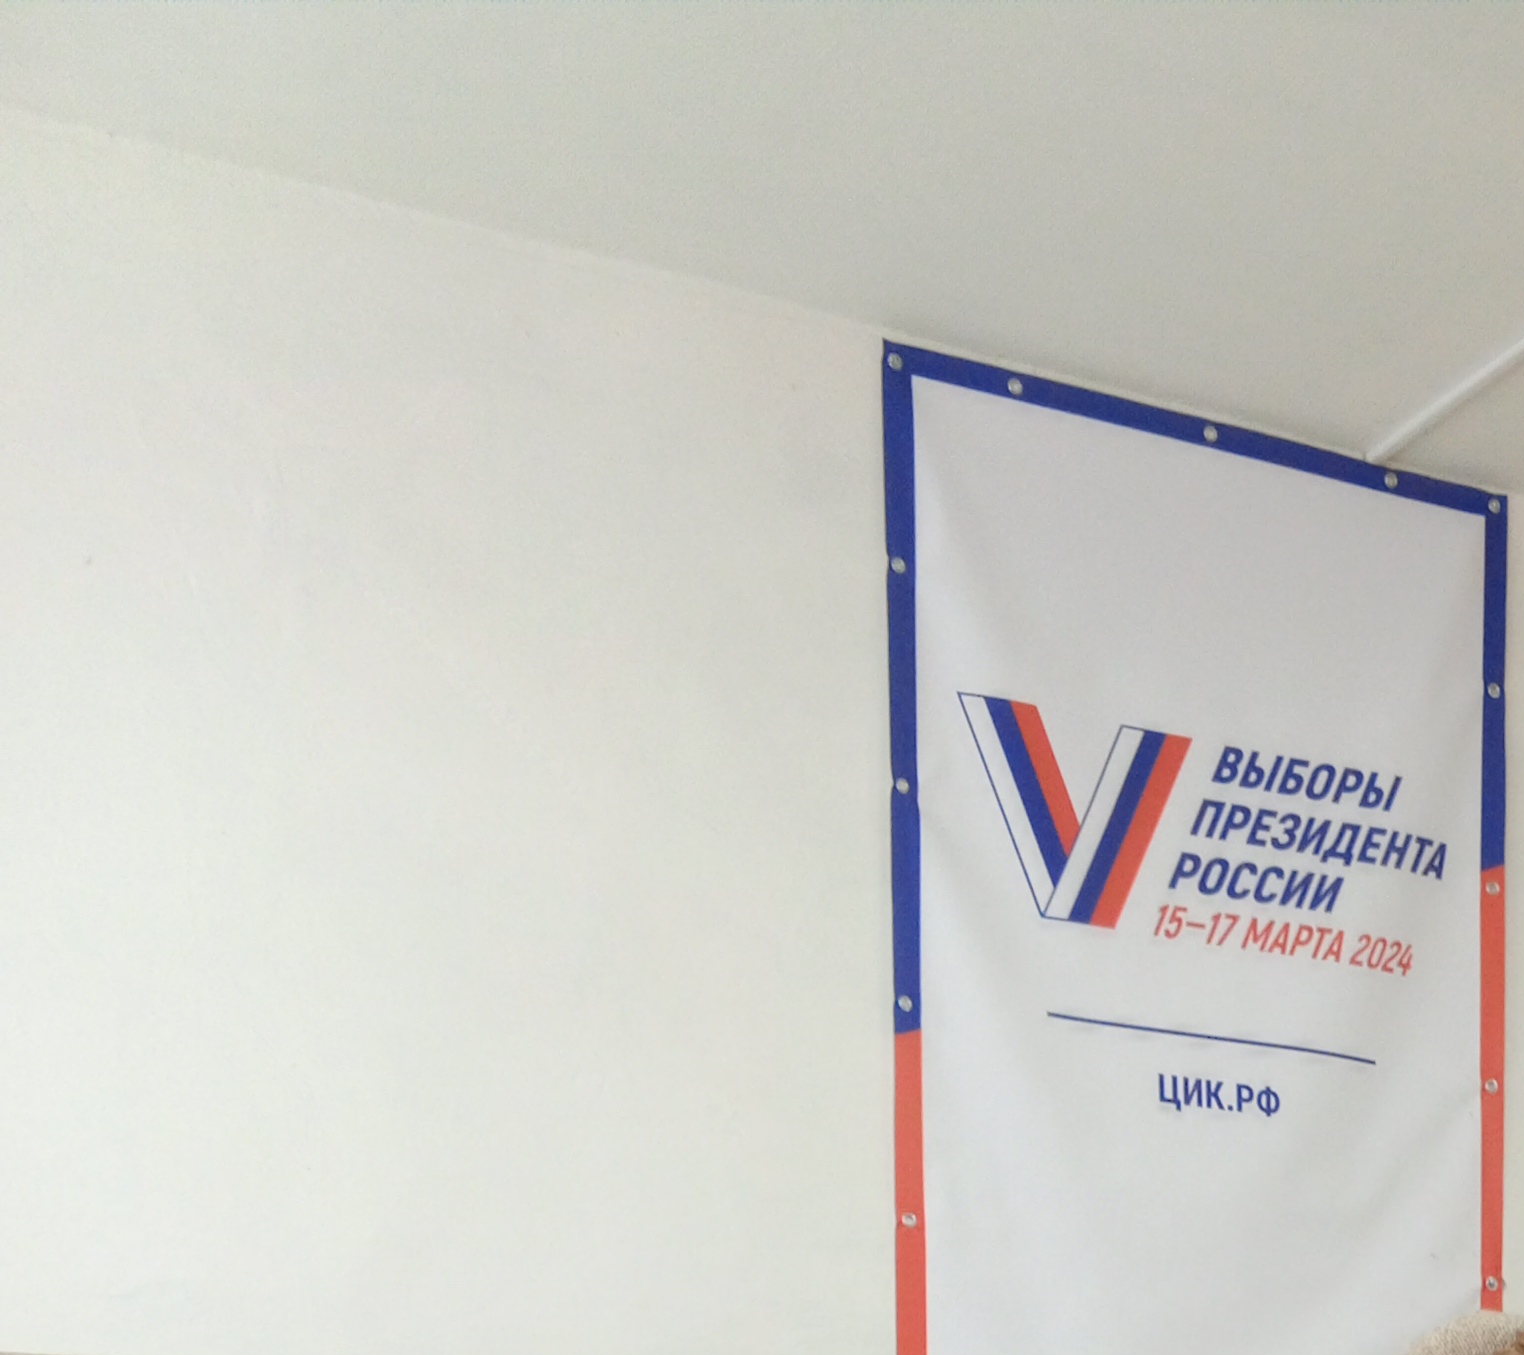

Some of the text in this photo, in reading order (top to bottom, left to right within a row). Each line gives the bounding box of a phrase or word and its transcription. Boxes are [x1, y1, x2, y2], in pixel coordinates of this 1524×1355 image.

[1211, 745, 1403, 812] ВЫБОРЫ
[1190, 798, 1448, 880] ПРЕЗИДЕНТА
[1168, 852, 1344, 914] РОССИИ
[1241, 920, 1345, 964] МАРТА
[1349, 933, 1414, 977] 2024
[1158, 1073, 1281, 1118] ЦИК.РФ
